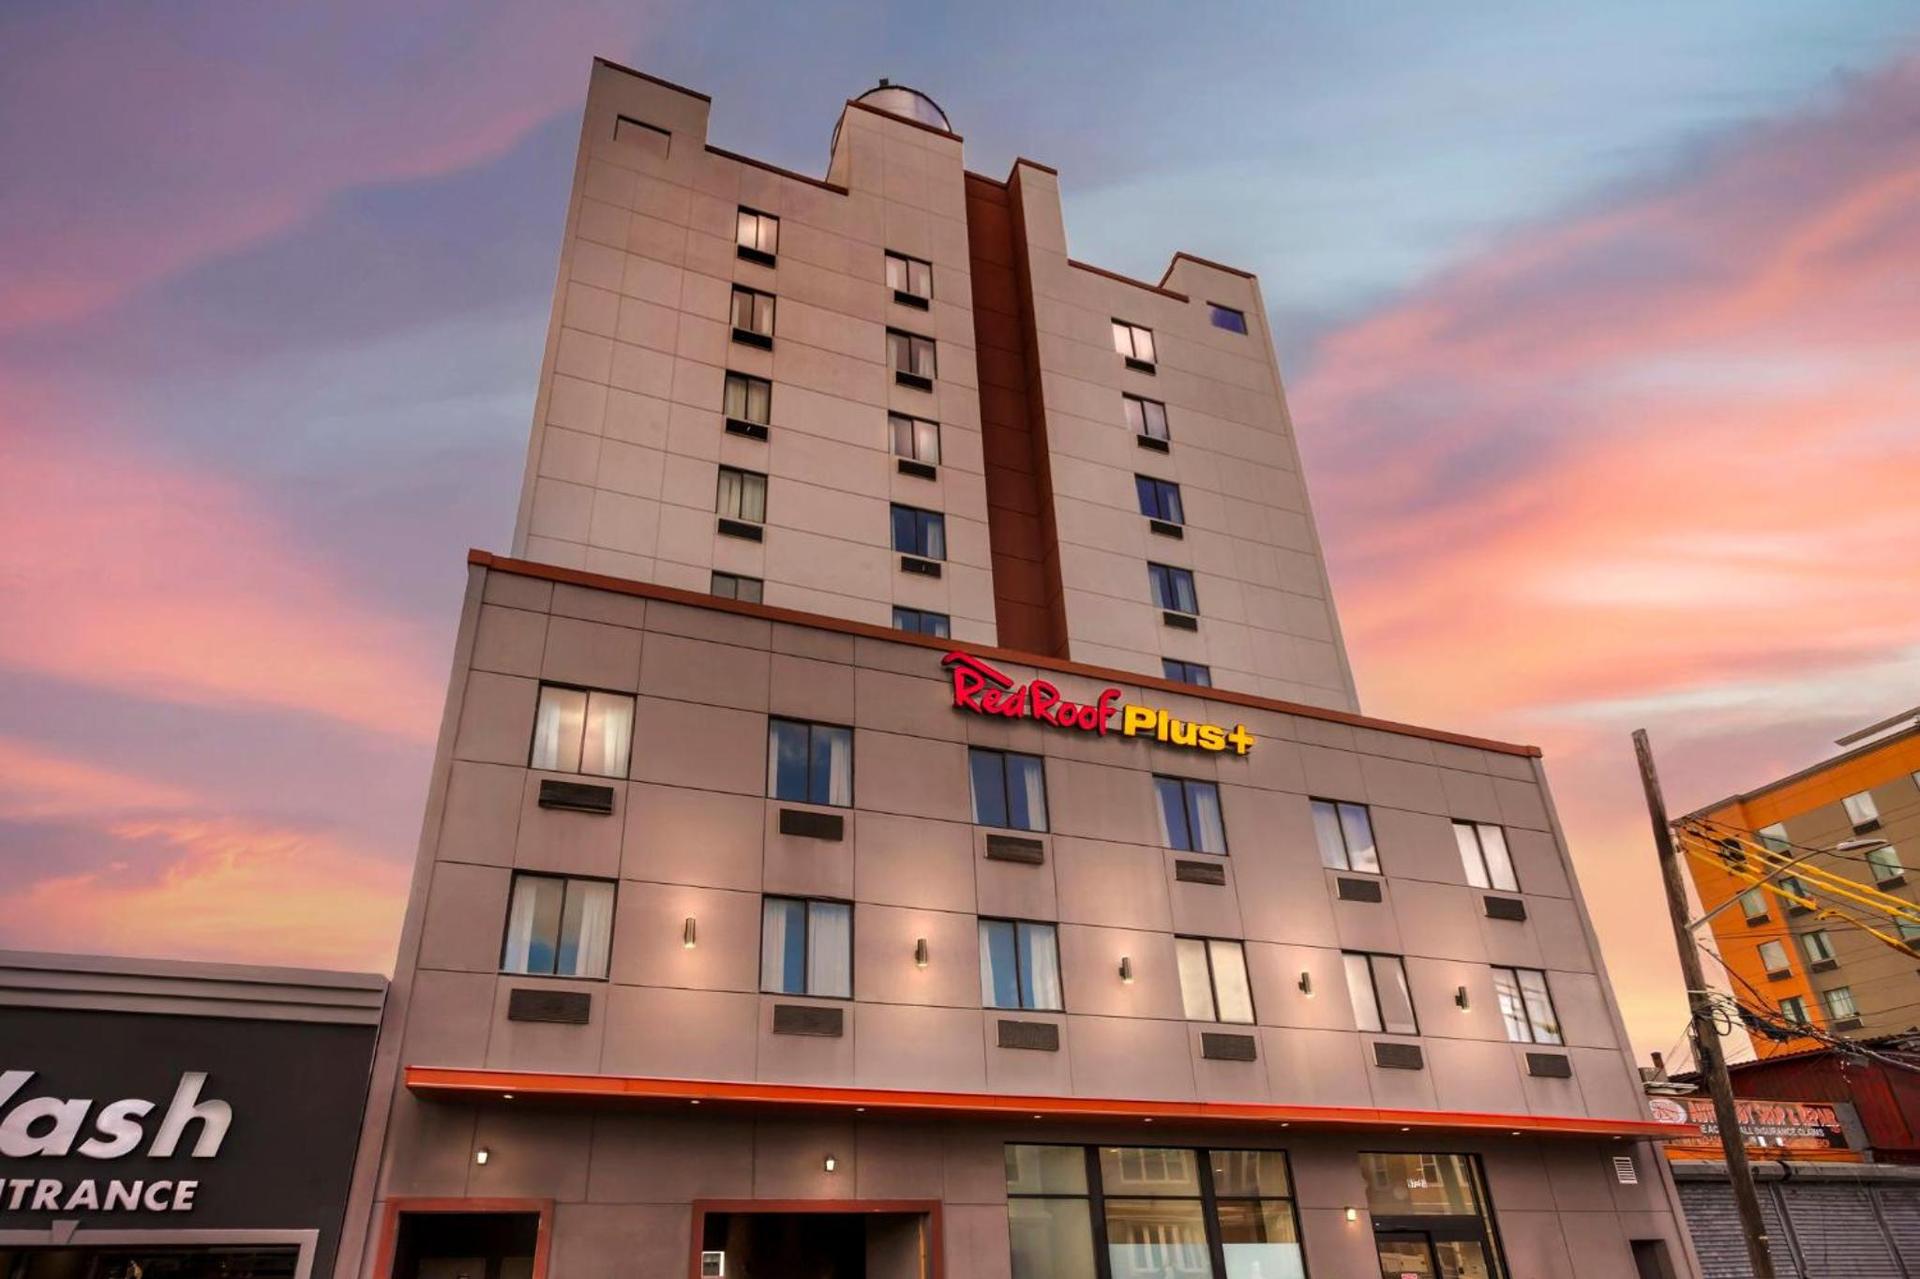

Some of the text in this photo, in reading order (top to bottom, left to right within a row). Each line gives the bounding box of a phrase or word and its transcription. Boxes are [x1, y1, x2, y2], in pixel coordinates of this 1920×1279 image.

[1123, 703, 1255, 755] Plus+
[0, 1070, 233, 1159] ash
[0, 1178, 198, 1212] TRANCE
